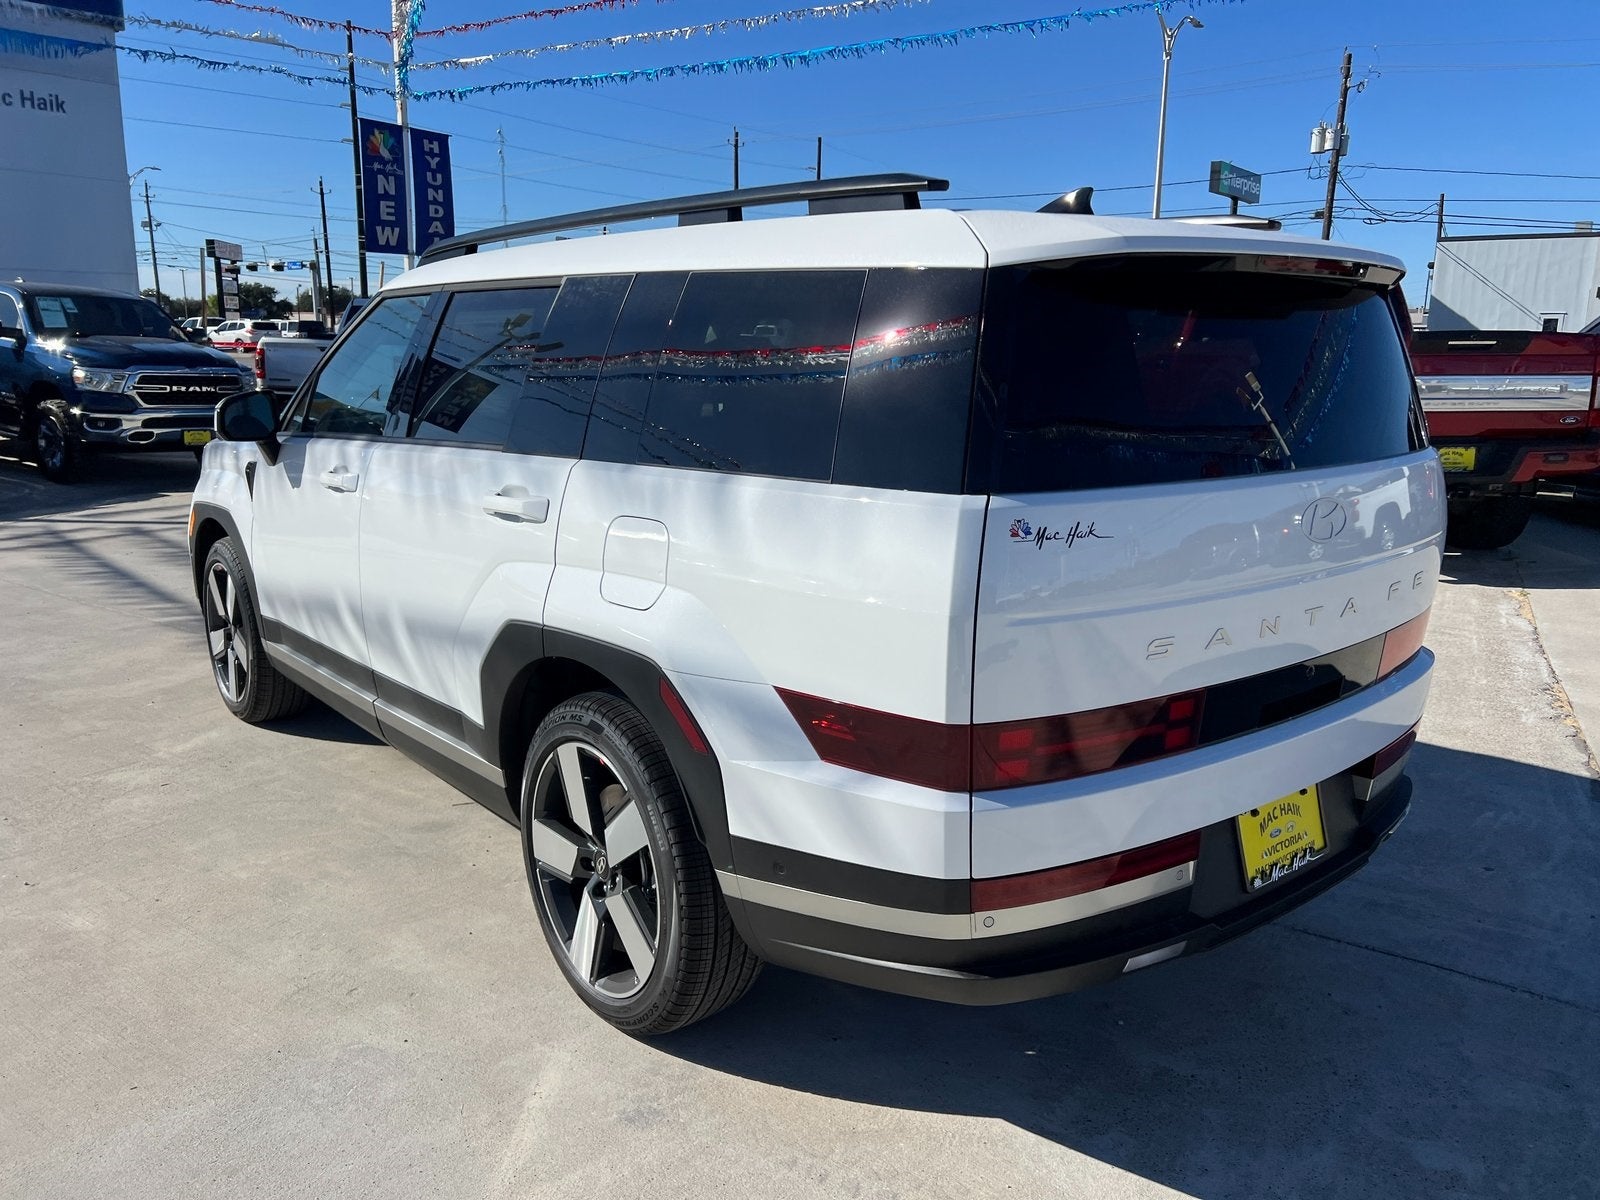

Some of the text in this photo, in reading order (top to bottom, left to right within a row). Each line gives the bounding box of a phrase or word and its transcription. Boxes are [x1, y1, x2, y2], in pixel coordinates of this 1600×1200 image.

[20, 89, 66, 114] Haik
[375, 174, 399, 247] NEW
[1027, 521, 1109, 551] Mac Haik
[1146, 570, 1424, 660] SANTA FE
[1259, 802, 1302, 837] MAC HAIK
